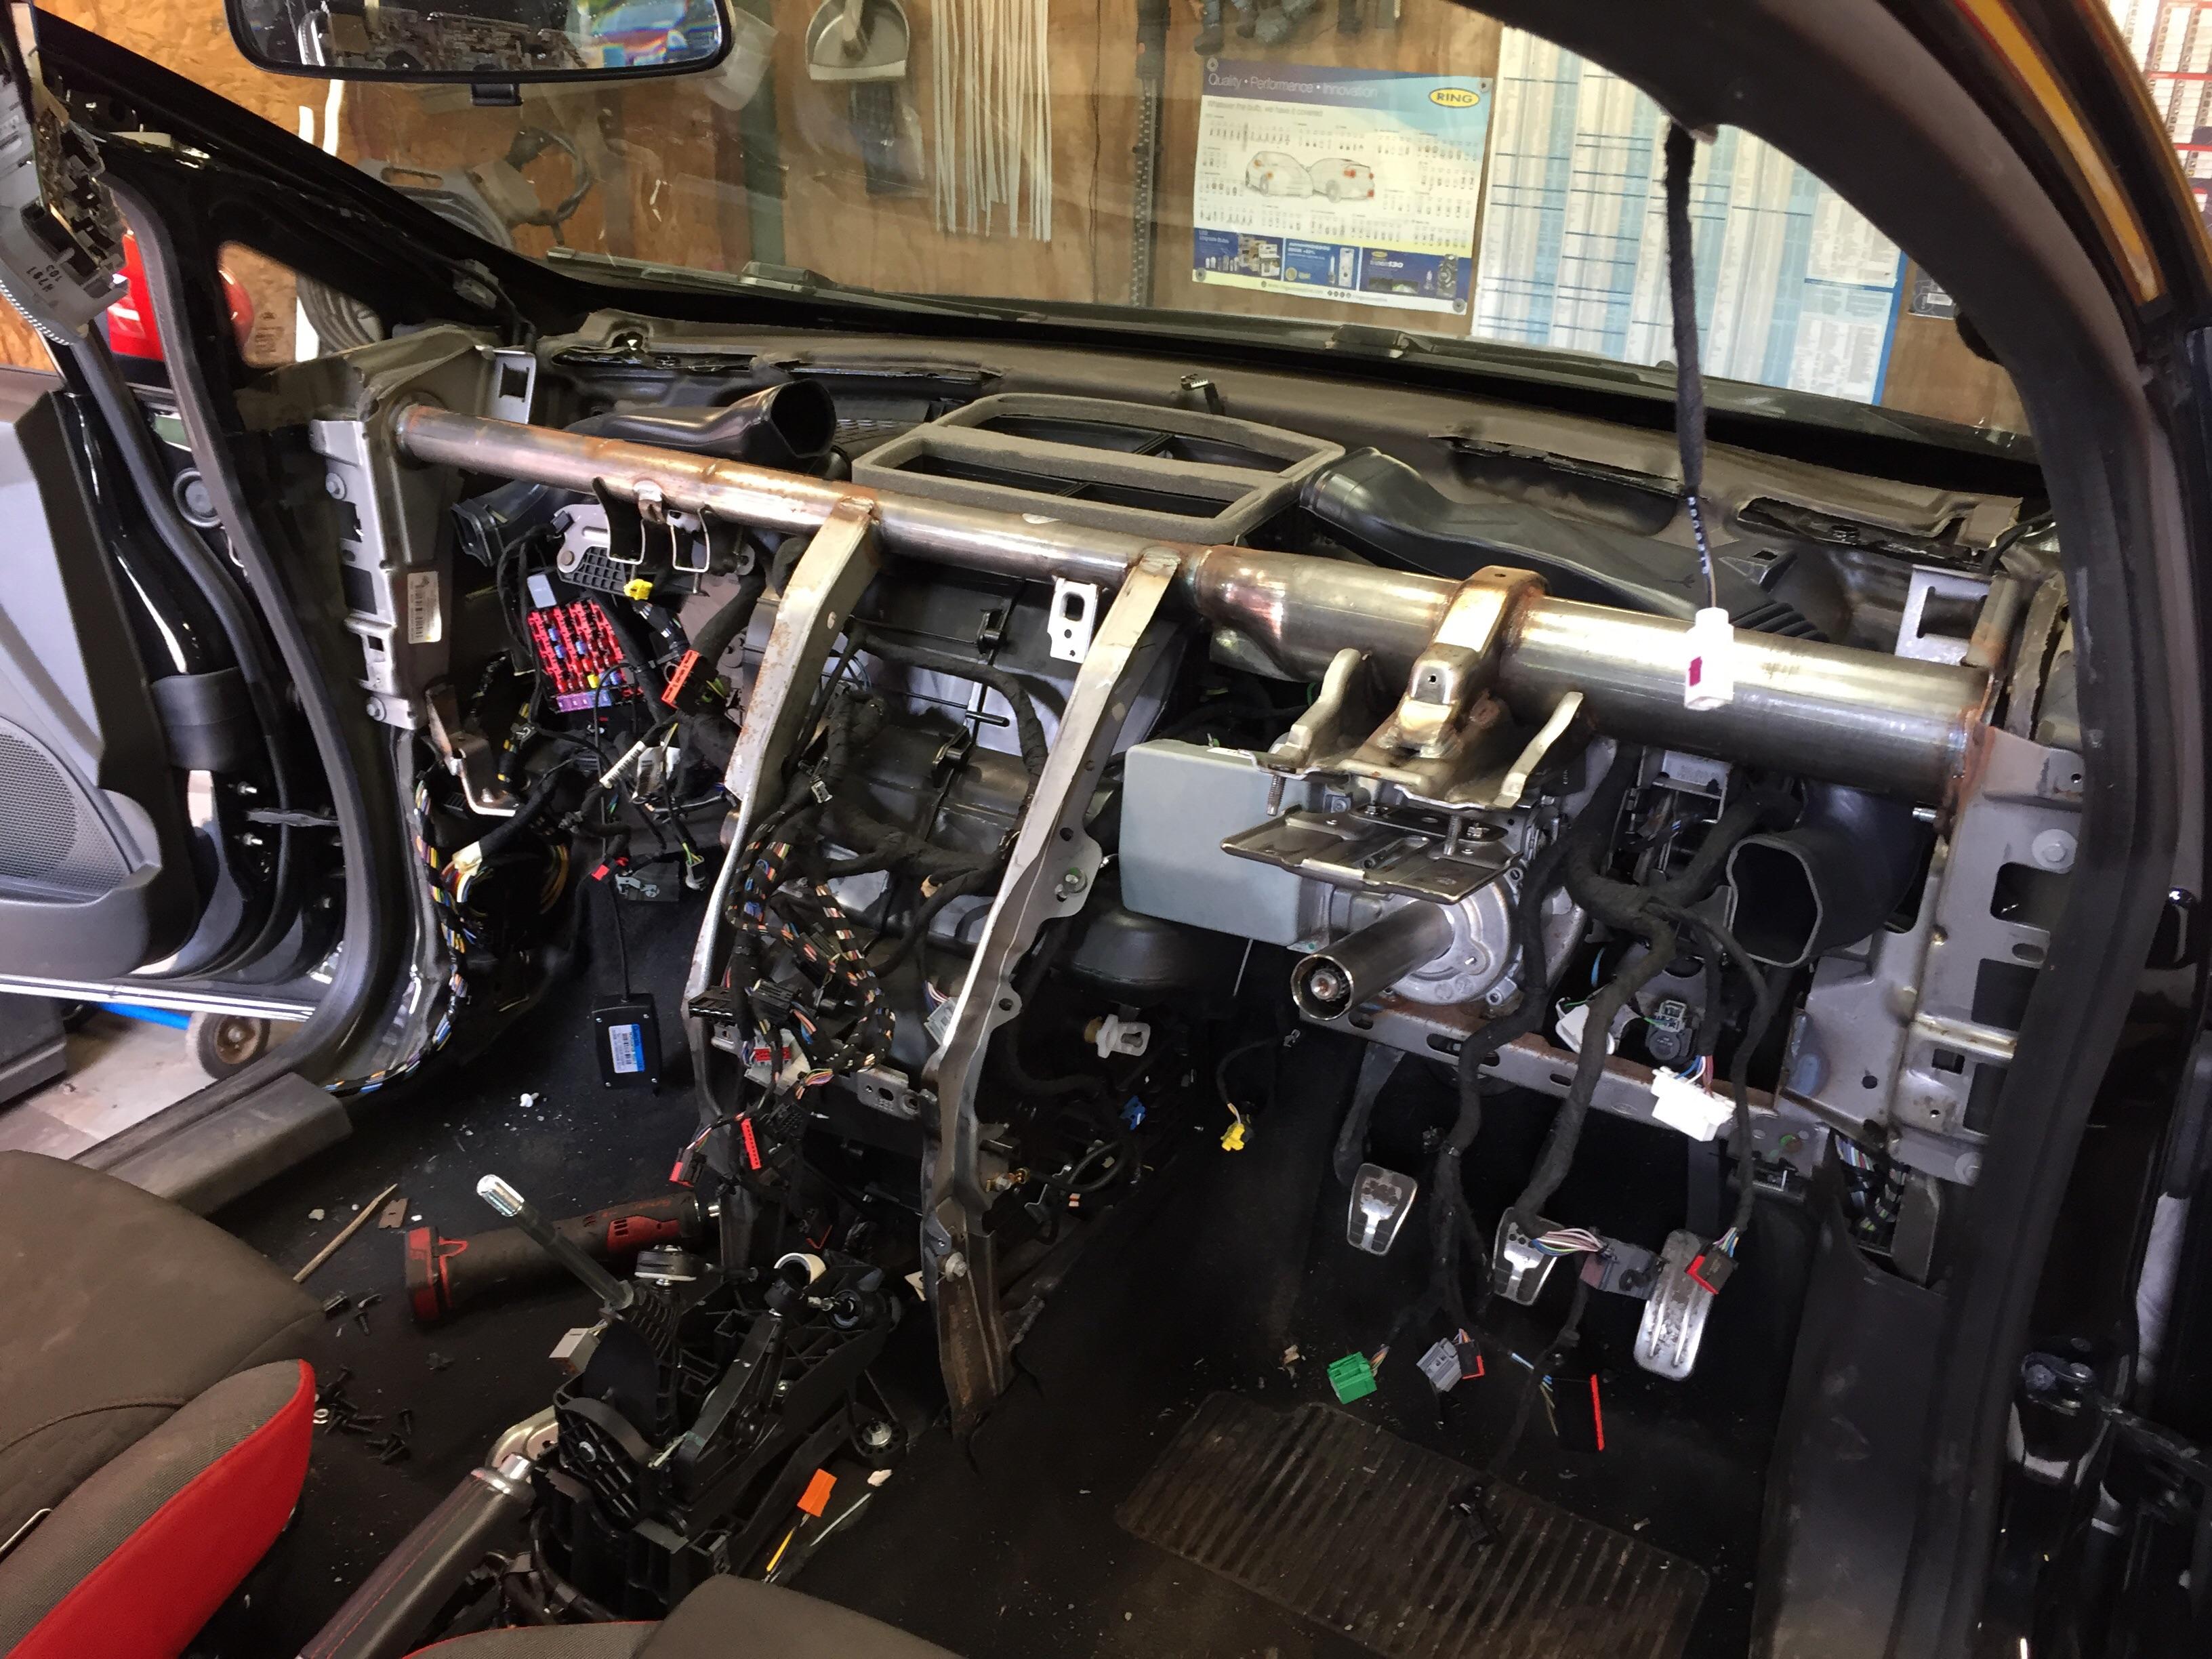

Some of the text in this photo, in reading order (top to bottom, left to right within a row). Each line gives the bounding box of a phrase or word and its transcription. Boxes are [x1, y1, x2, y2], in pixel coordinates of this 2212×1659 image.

[1208, 73, 1378, 98] Quality Performance Innovation
[1436, 92, 1473, 103] RING
